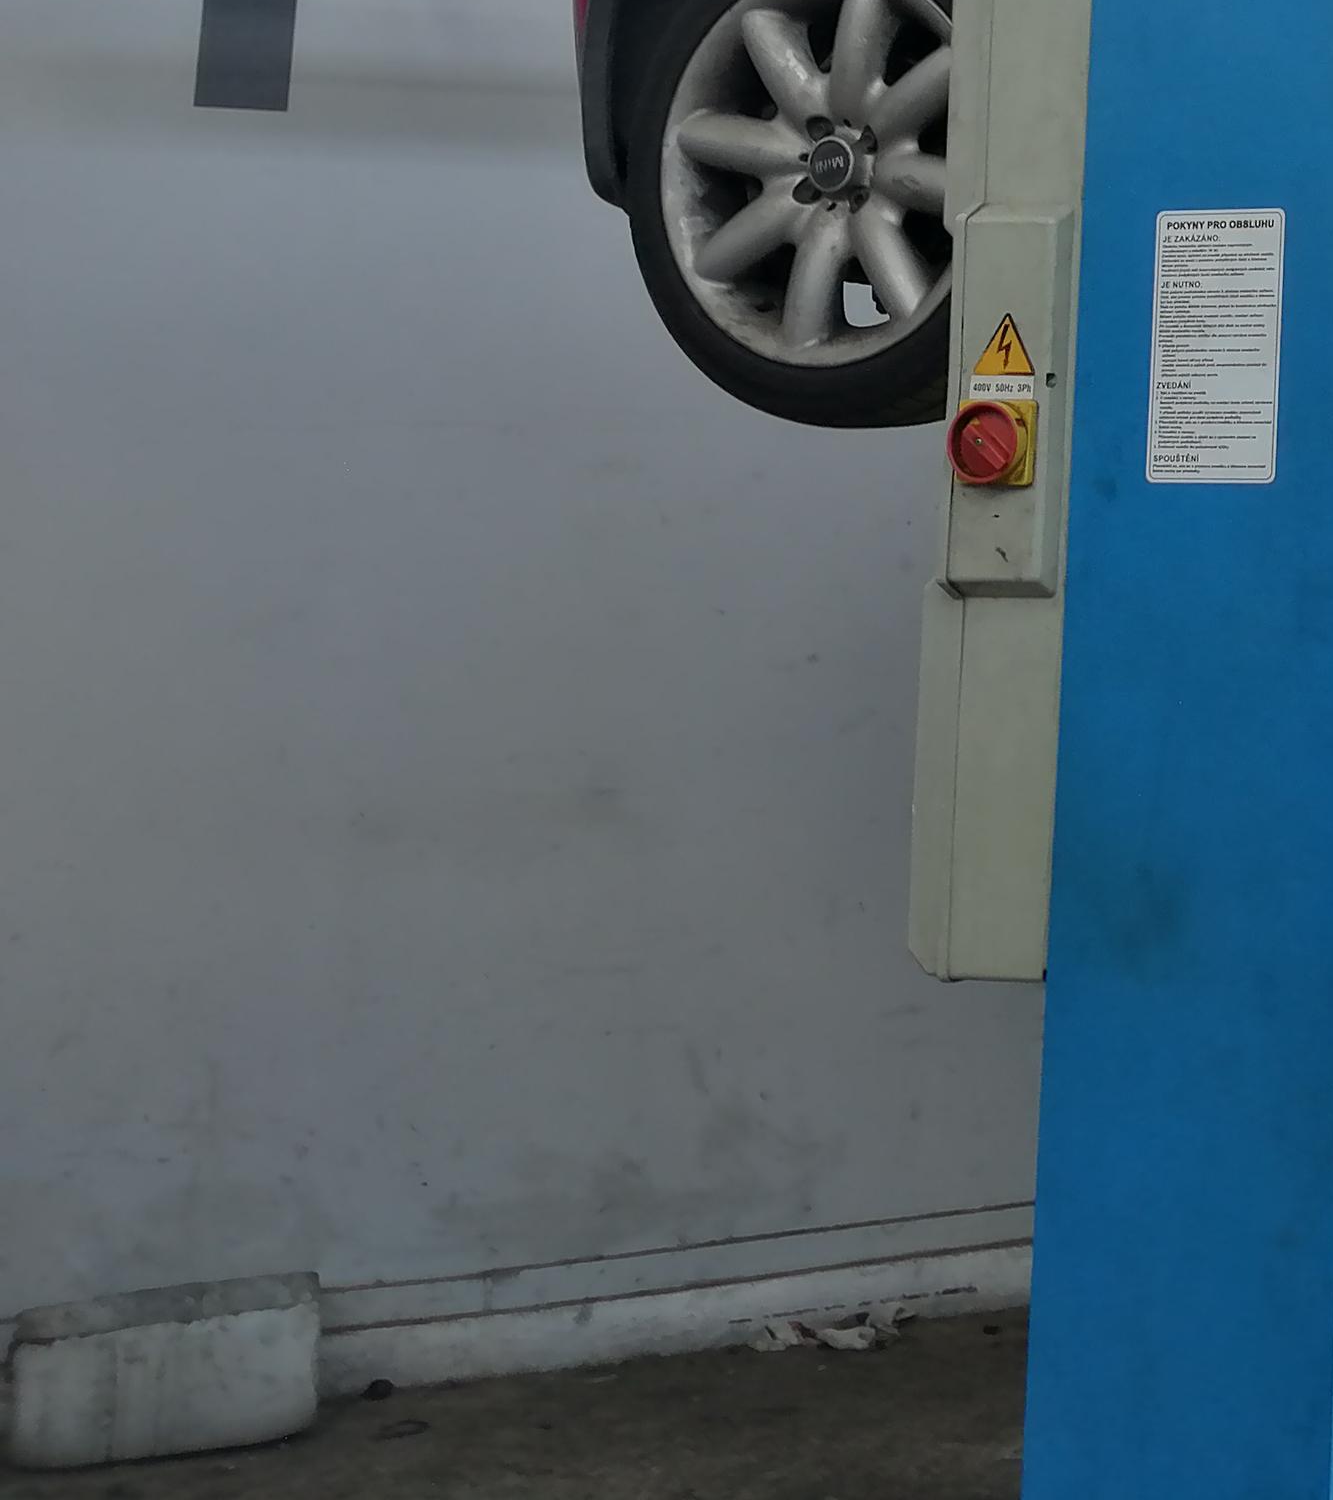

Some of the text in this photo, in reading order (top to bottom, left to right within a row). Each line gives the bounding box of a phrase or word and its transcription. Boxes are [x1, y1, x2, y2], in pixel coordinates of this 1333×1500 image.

[815, 155, 844, 173] MINI
[1167, 219, 1275, 230] POKYNY PRO OBSLUHU
[1162, 235, 1172, 243] JE
[1161, 280, 1170, 289] JE
[973, 383, 1031, 392] 400V 50Hz 3Ph
[1156, 380, 1191, 389] ZVEDÁNÍ
[1153, 453, 1199, 462] SPOUŠTĚNÍ
